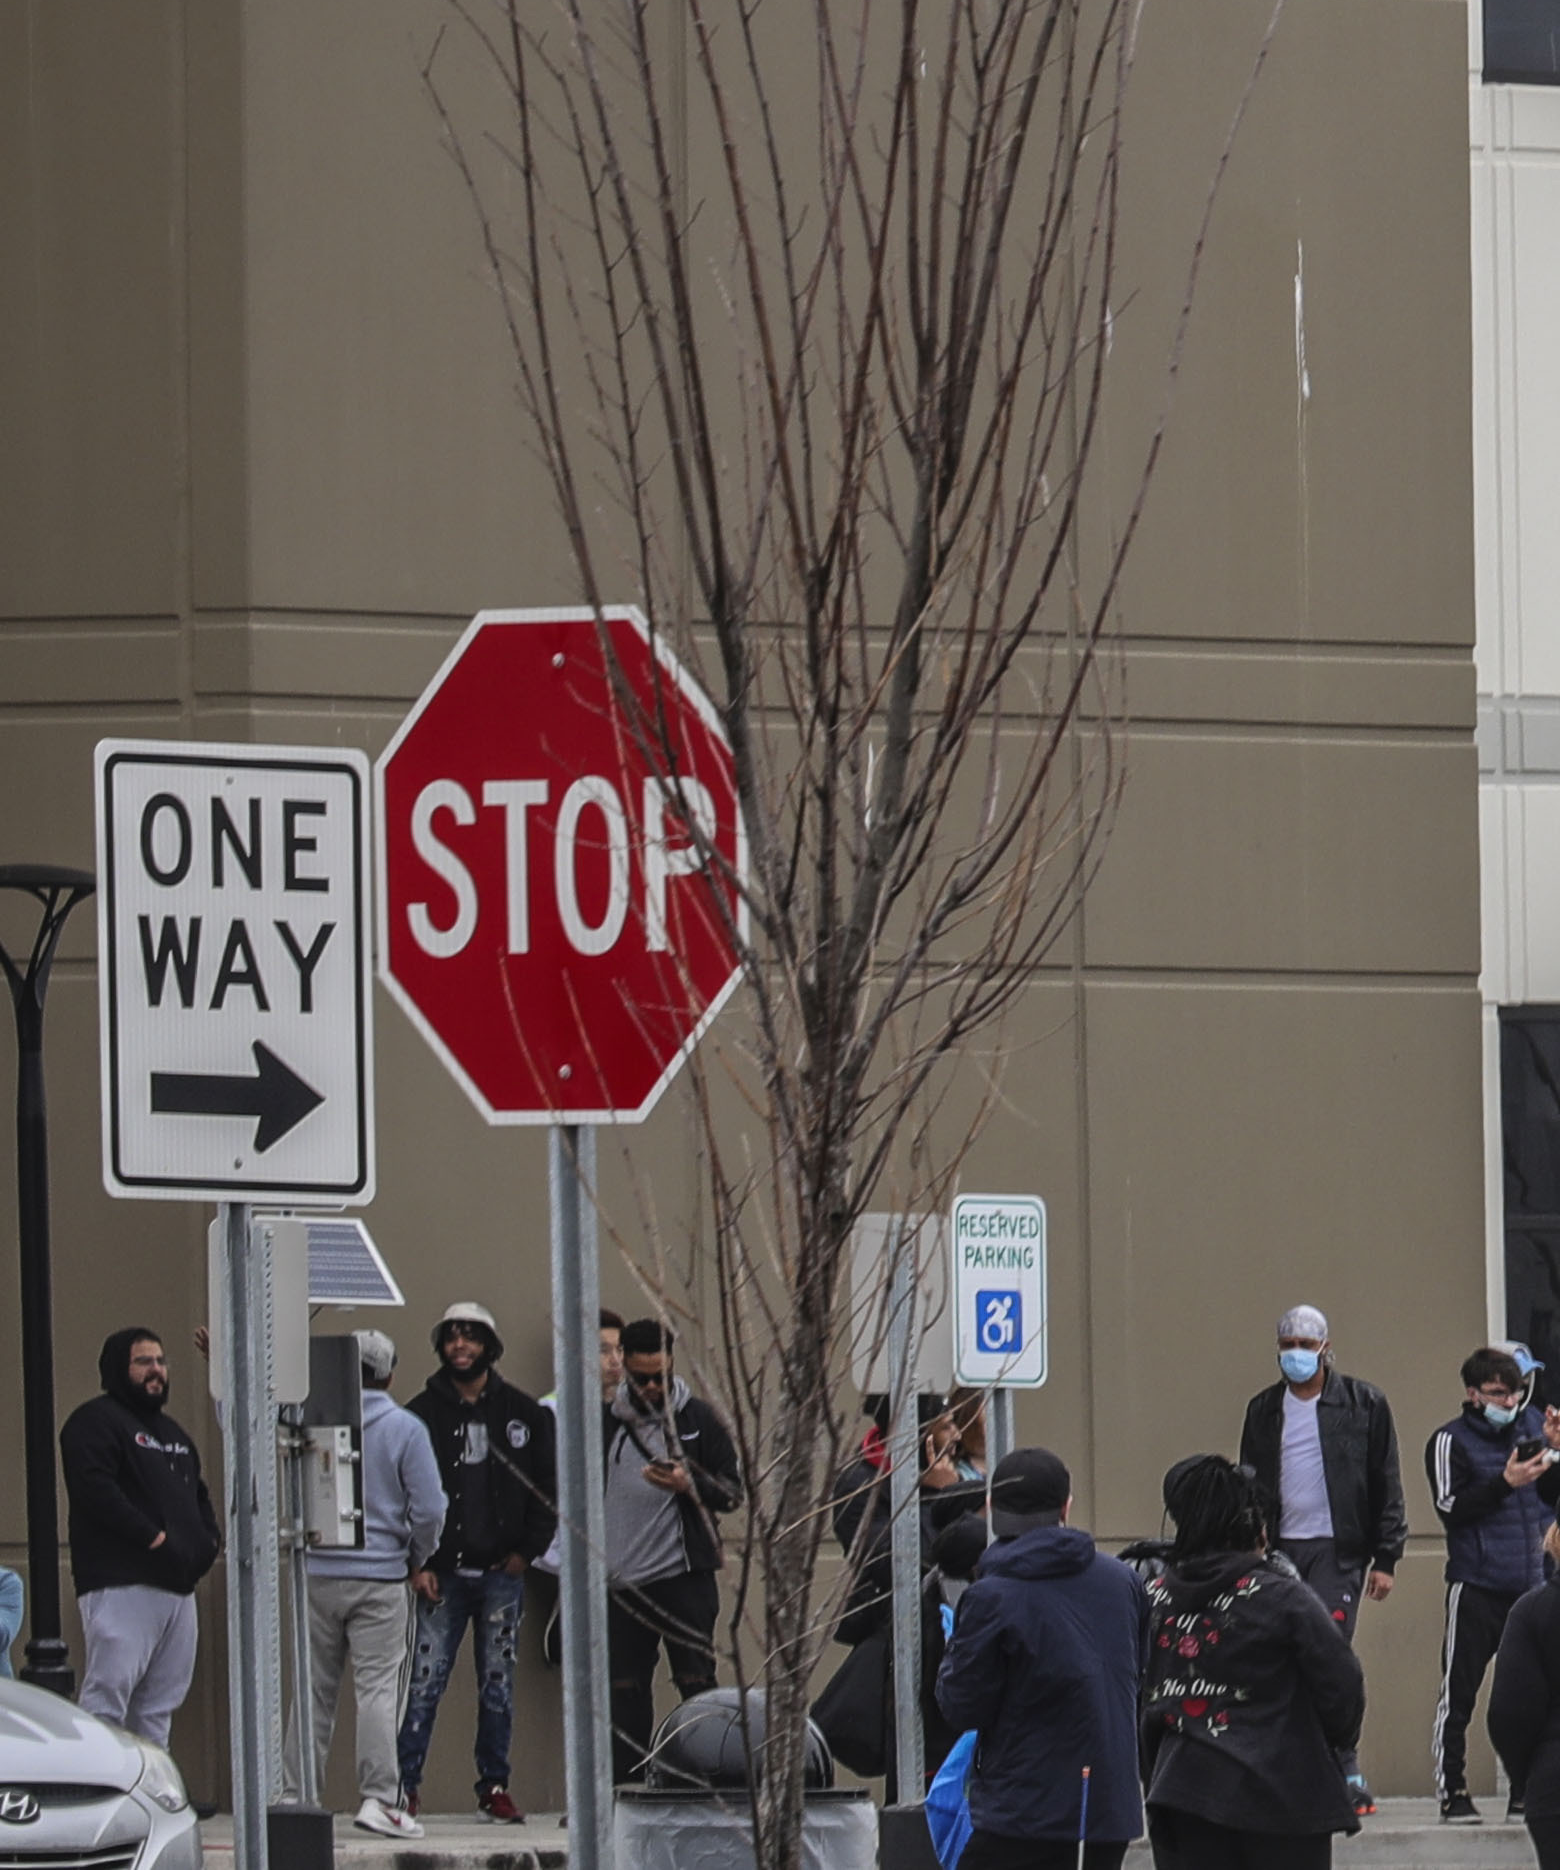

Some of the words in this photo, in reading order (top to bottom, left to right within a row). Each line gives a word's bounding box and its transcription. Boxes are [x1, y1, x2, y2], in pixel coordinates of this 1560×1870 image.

[139, 792, 330, 893] ONE
[406, 775, 717, 958] STOP
[137, 914, 337, 1014] WAY
[960, 1214, 1039, 1238] RESERVED
[965, 1245, 1034, 1269] PARKING
[1162, 1679, 1186, 1697] No
[1191, 1679, 1227, 1696] One
